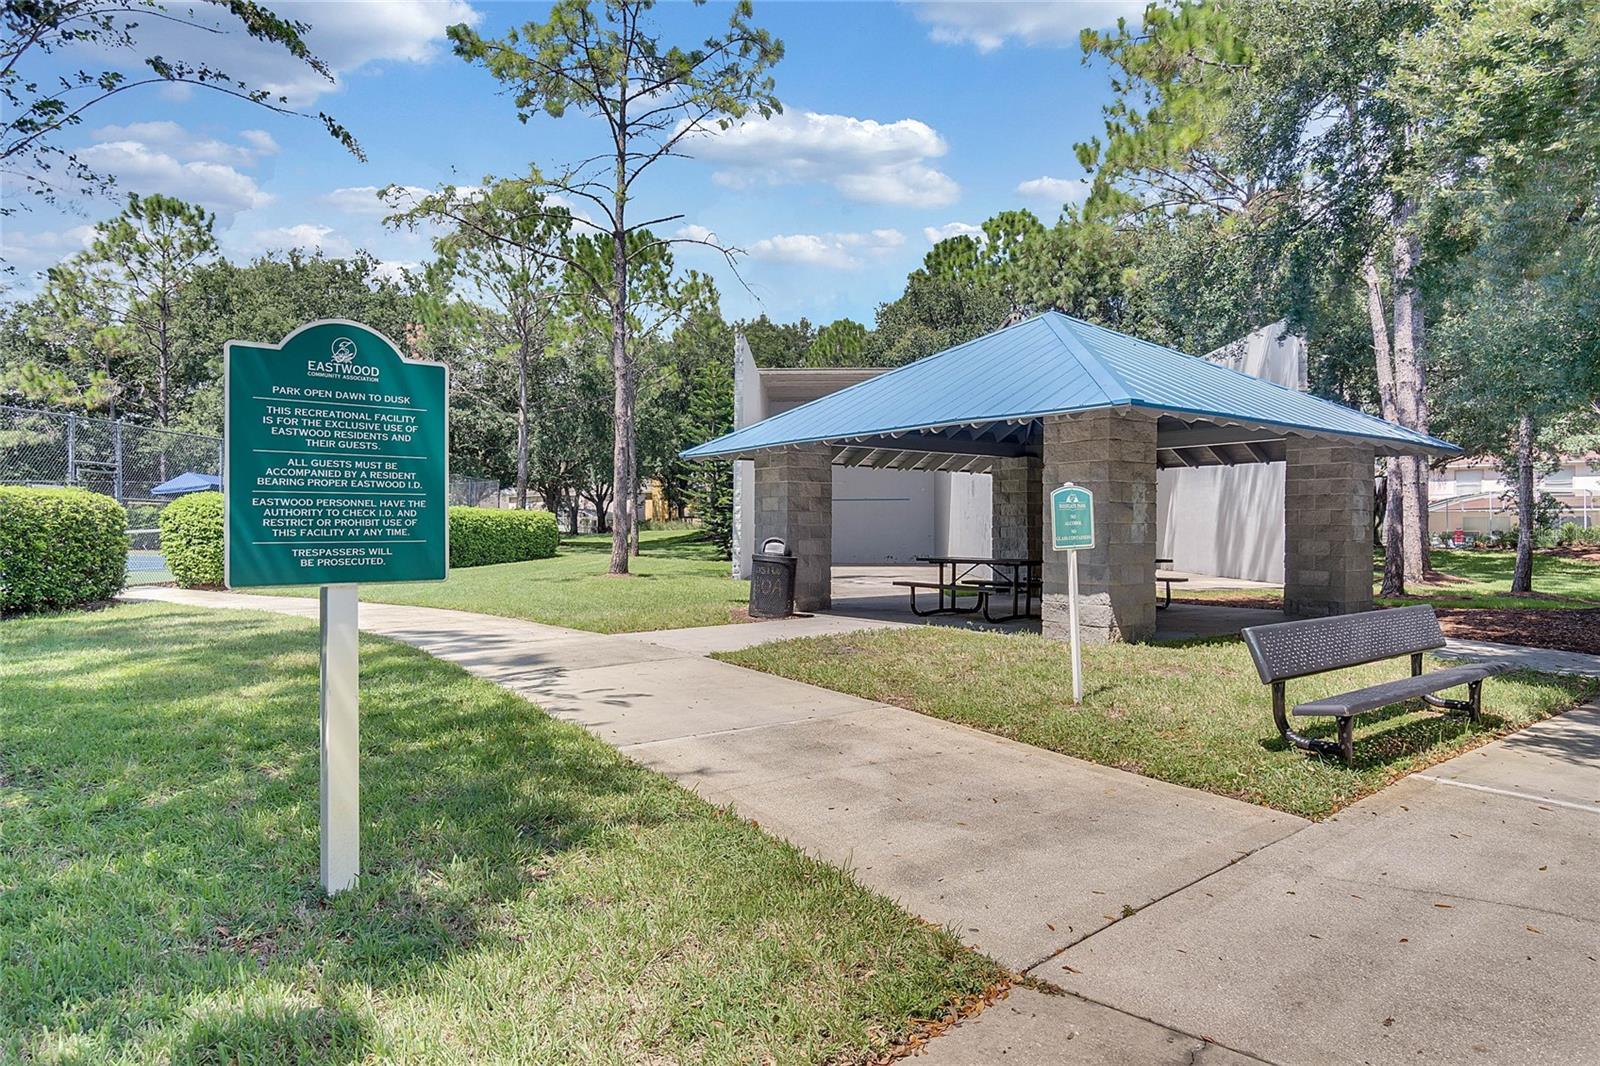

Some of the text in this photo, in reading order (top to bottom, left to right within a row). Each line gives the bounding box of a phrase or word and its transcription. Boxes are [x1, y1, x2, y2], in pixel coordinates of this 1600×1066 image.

[308, 361, 379, 377] EASTWOOD
[307, 371, 379, 382] COMMUNITY ASSOCIATION
[272, 386, 410, 404] PARK OPEN DAWN TO DUSK
[266, 406, 416, 423] THIS RECREATIONAL FACILITY
[263, 416, 418, 433] IS FOR THE EXCLUSIVE USE OF
[271, 427, 411, 442] EASTWOOD RESIDENTS AND
[306, 439, 381, 450] THEIR GUESTS.
[288, 459, 308, 467] ALL
[311, 460, 352, 468] GUESTS
[385, 462, 397, 470] BE
[266, 468, 341, 478] ACCOMPANIED
[257, 478, 304, 486] BEARING
[308, 479, 348, 487] PROPER
[252, 498, 426, 508] EASTWOOD PERSONNEL HAVE THE
[264, 509, 323, 517] AUTHORITY
[326, 509, 339, 517] TO
[342, 509, 375, 517] CHECK
[263, 519, 314, 527] RESTRICT
[317, 519, 332, 527] OR
[272, 529, 297, 537] THIS
[300, 529, 345, 537] FACILITY
[292, 549, 365, 557] TRESPASSERS
[301, 558, 386, 567] BE PROSECUTED.
